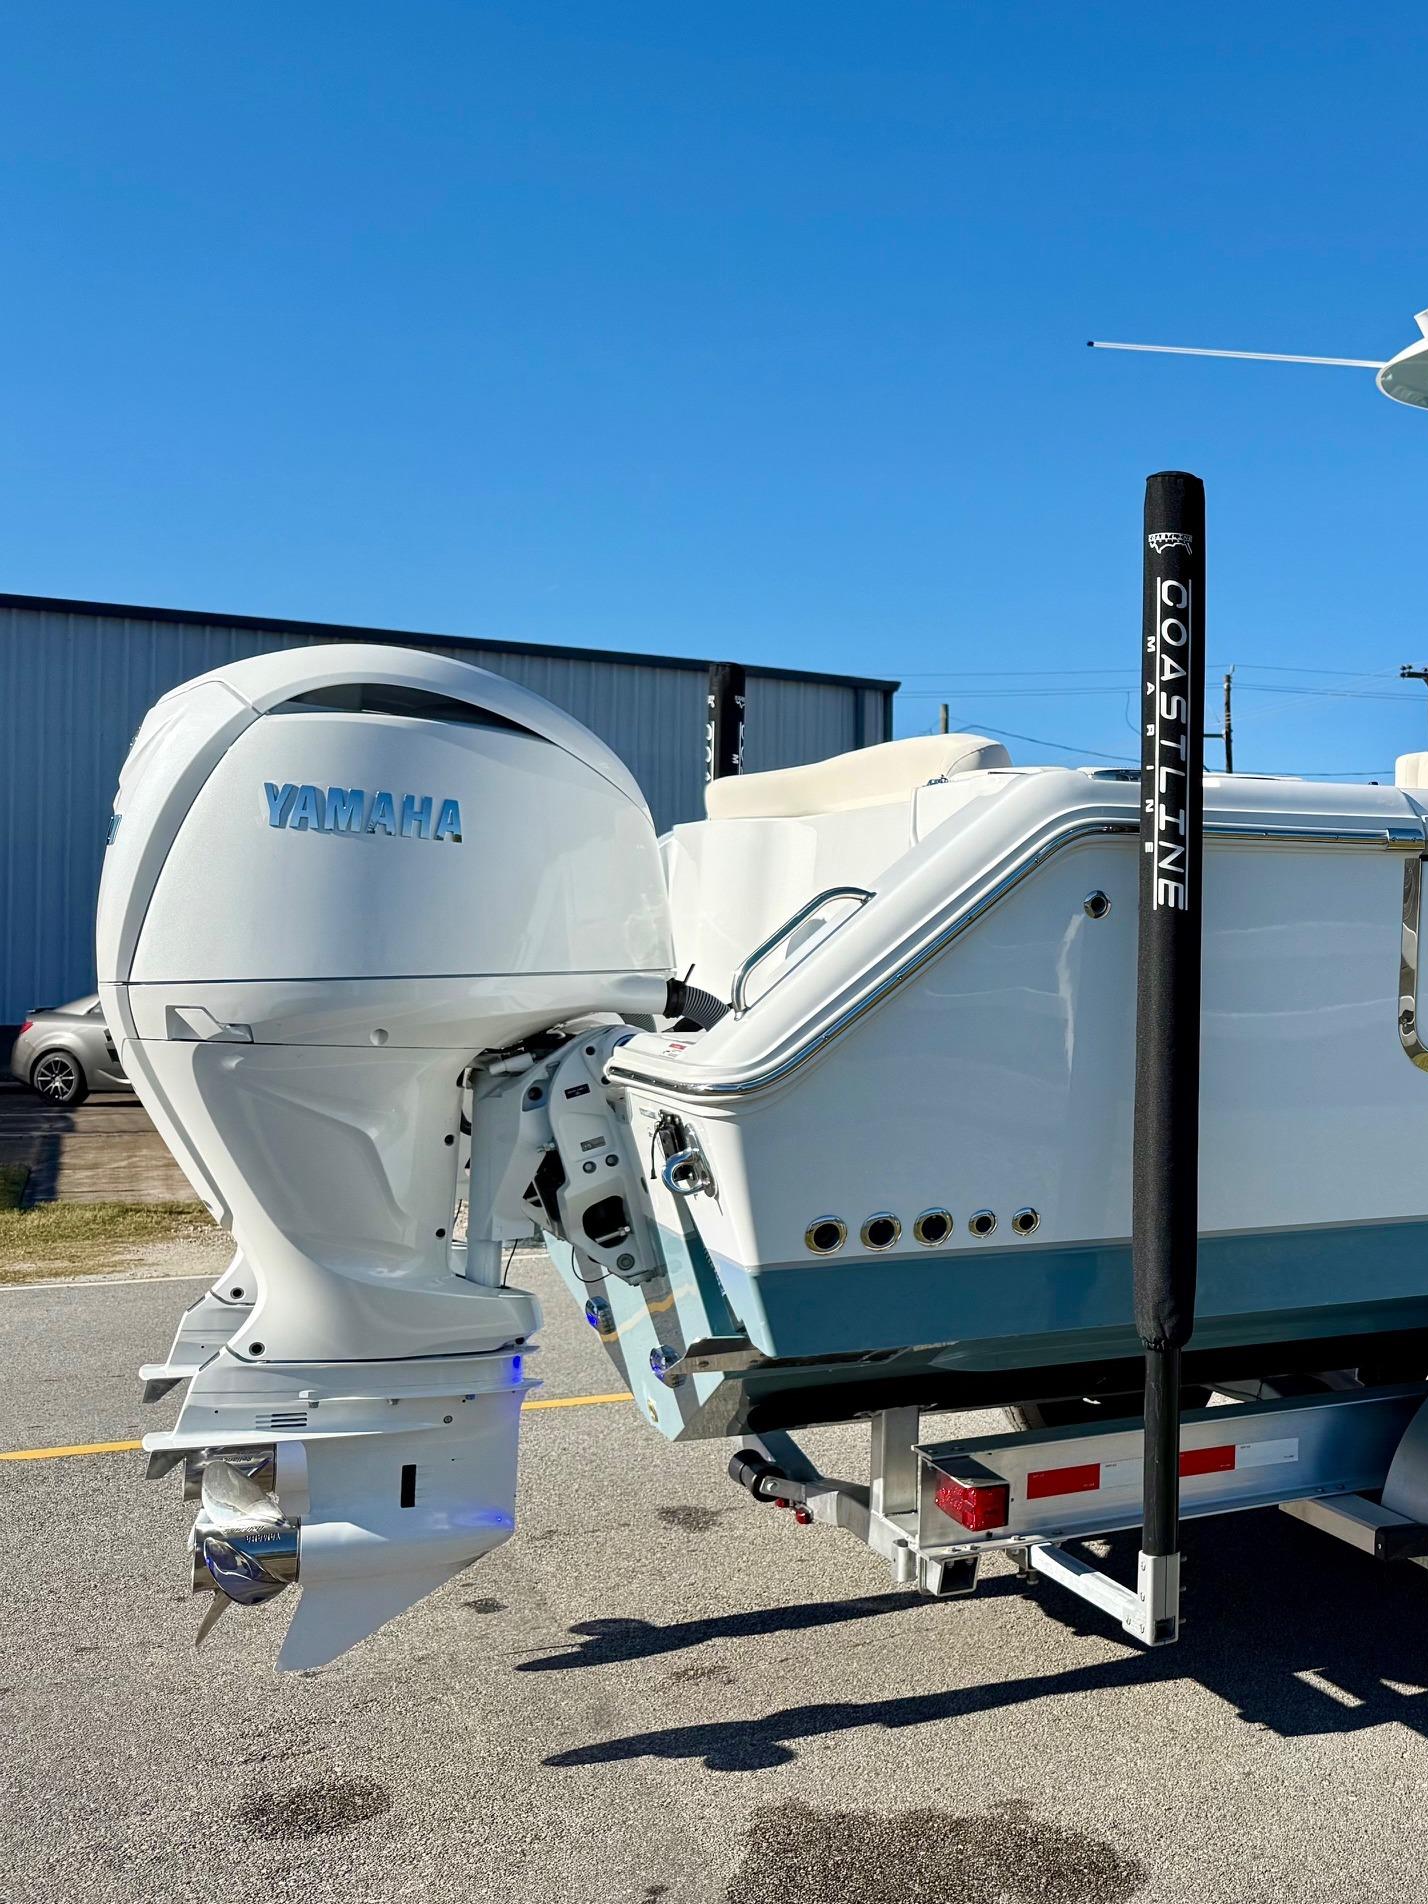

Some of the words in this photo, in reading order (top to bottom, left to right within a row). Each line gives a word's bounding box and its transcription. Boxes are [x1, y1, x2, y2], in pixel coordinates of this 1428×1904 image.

[264, 782, 462, 843] YAMAHA
[1144, 636, 1156, 853] MARINE
[1158, 580, 1187, 910] COASTLINE
